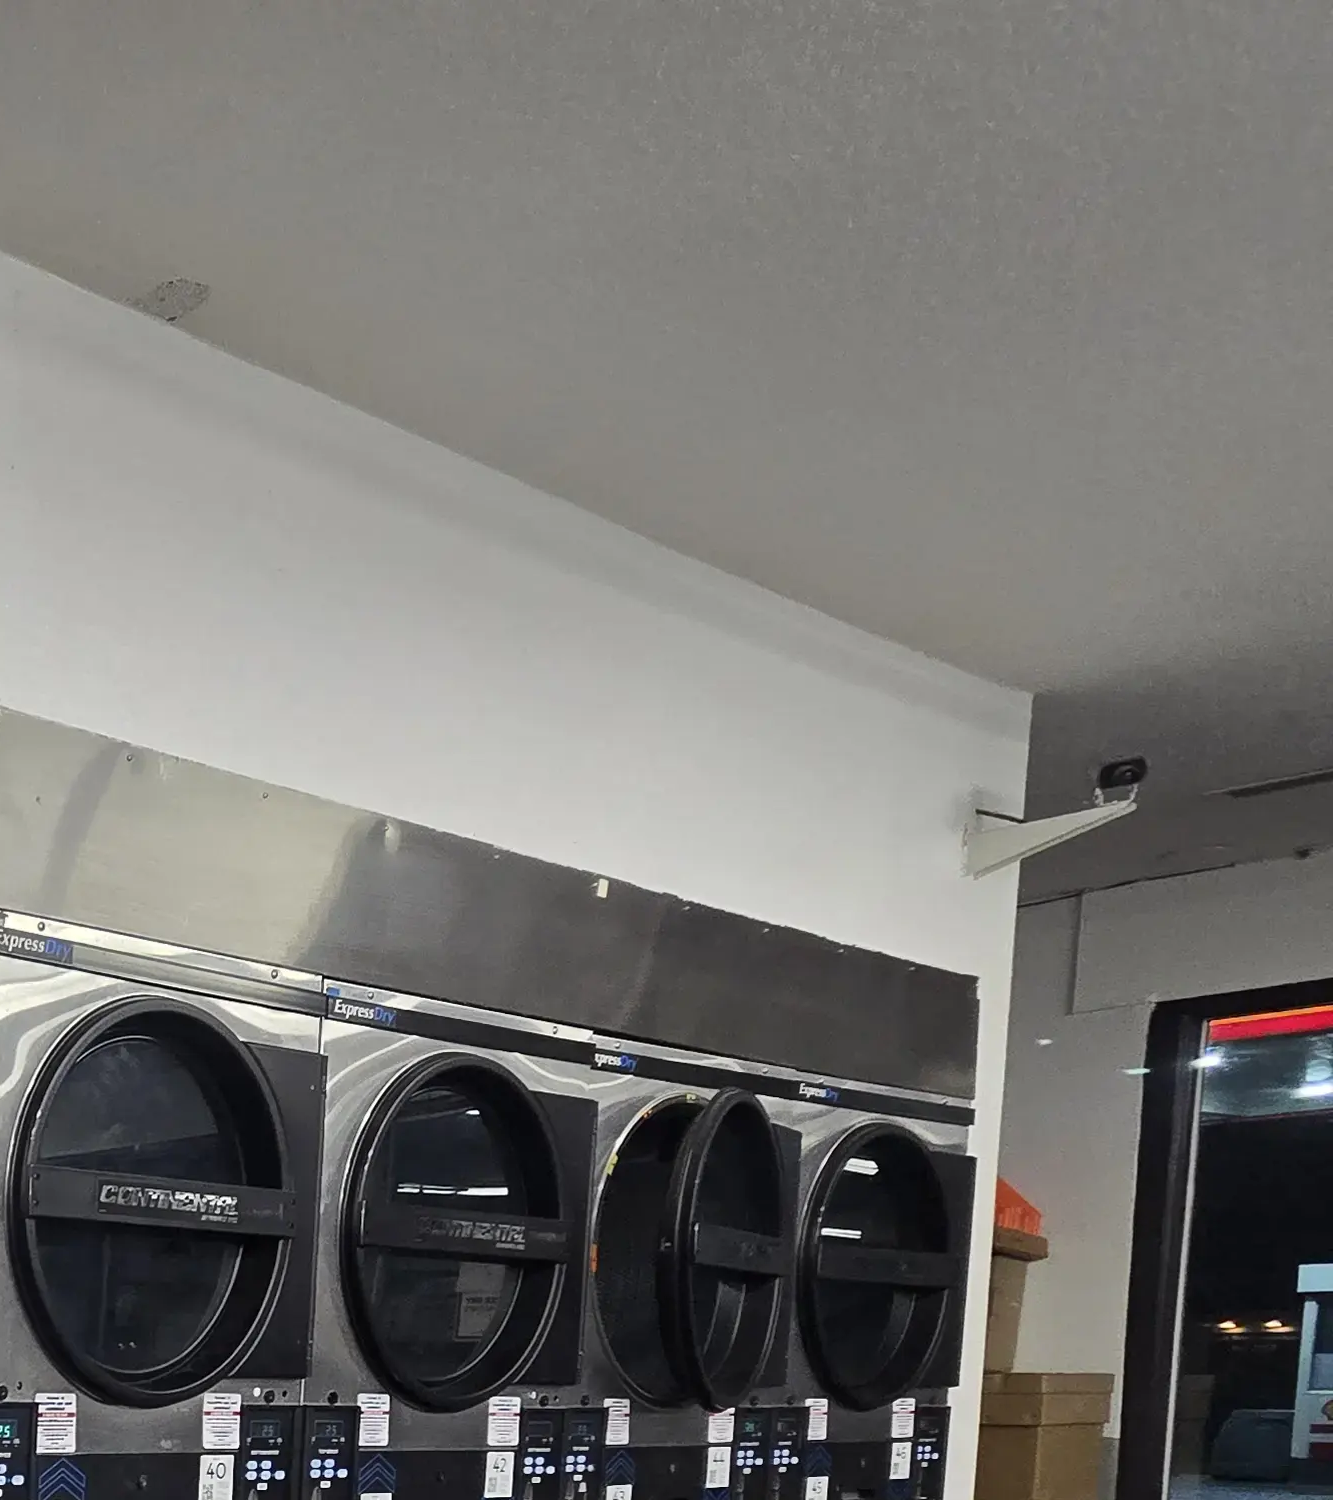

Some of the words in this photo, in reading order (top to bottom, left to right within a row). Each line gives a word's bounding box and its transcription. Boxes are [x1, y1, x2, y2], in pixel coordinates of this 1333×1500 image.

[334, 999, 396, 1026] ExpressDry
[206, 1462, 226, 1479] 40
[493, 1457, 507, 1473] 42
